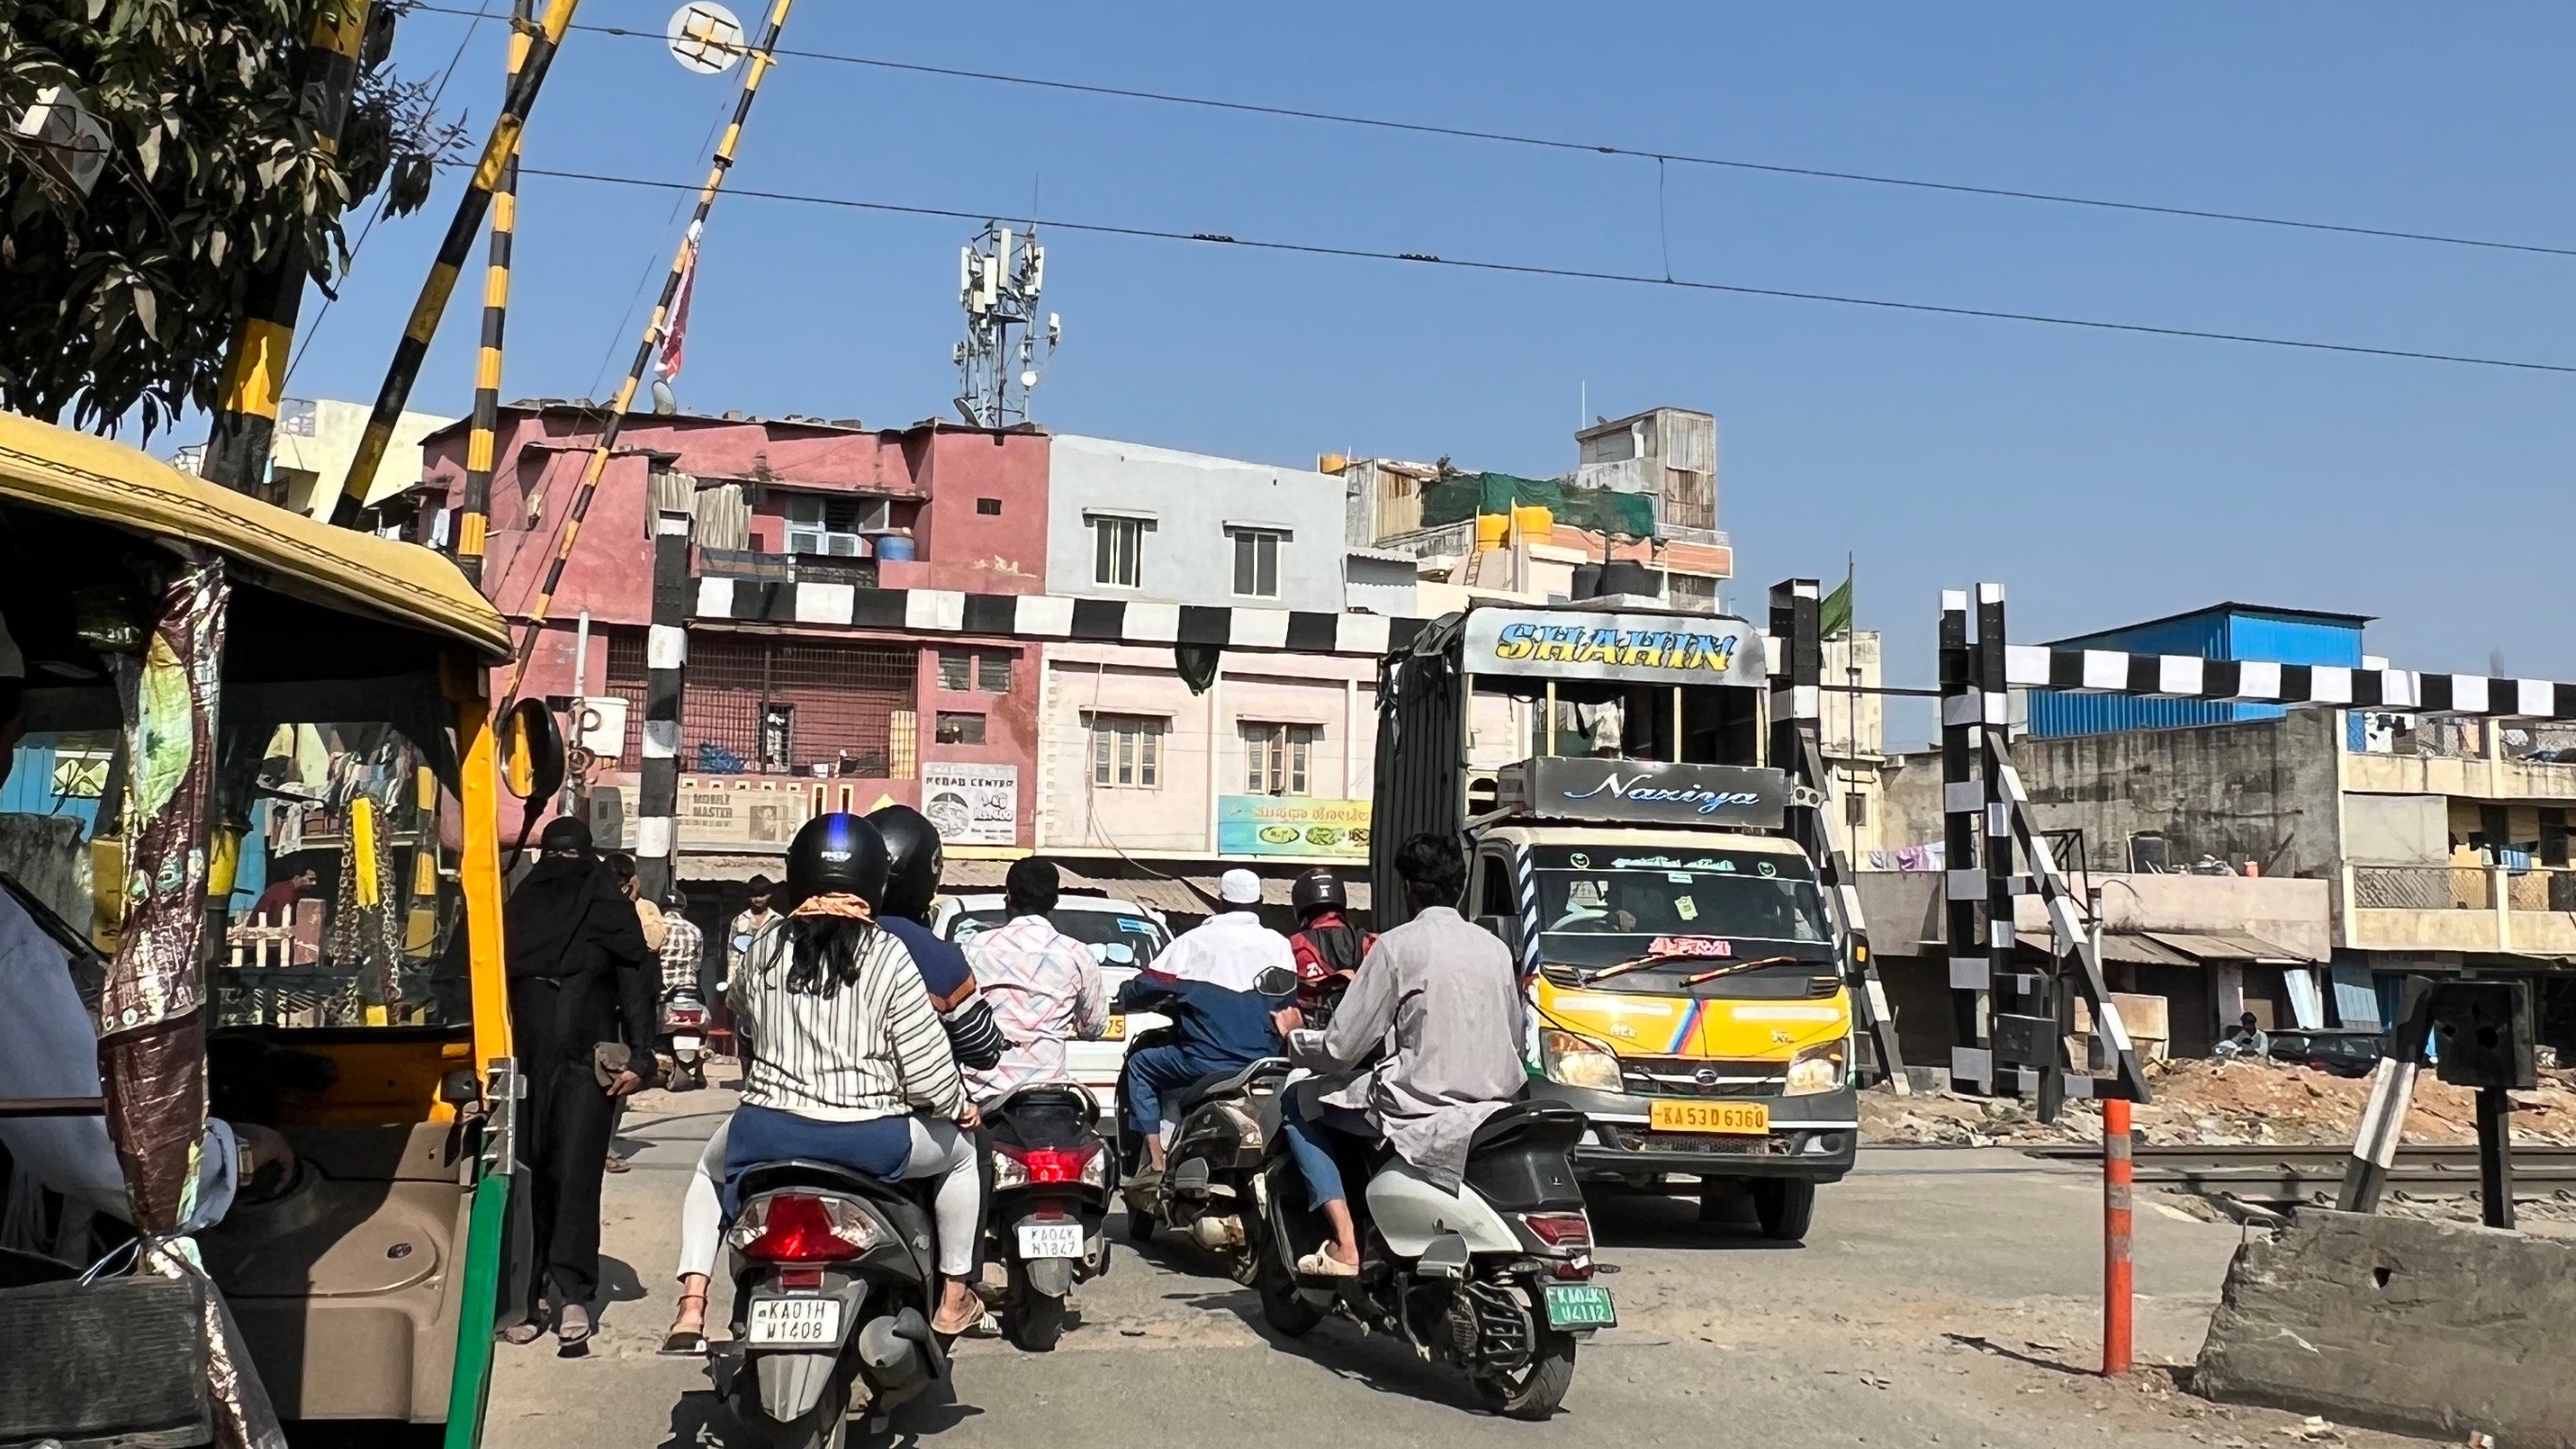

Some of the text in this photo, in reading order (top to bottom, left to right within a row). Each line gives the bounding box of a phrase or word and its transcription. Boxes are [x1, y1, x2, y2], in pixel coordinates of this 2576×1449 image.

[1495, 623, 1738, 672] SHAHIN
[769, 1301, 825, 1319] KA01H
[767, 1321, 823, 1340] W1408
